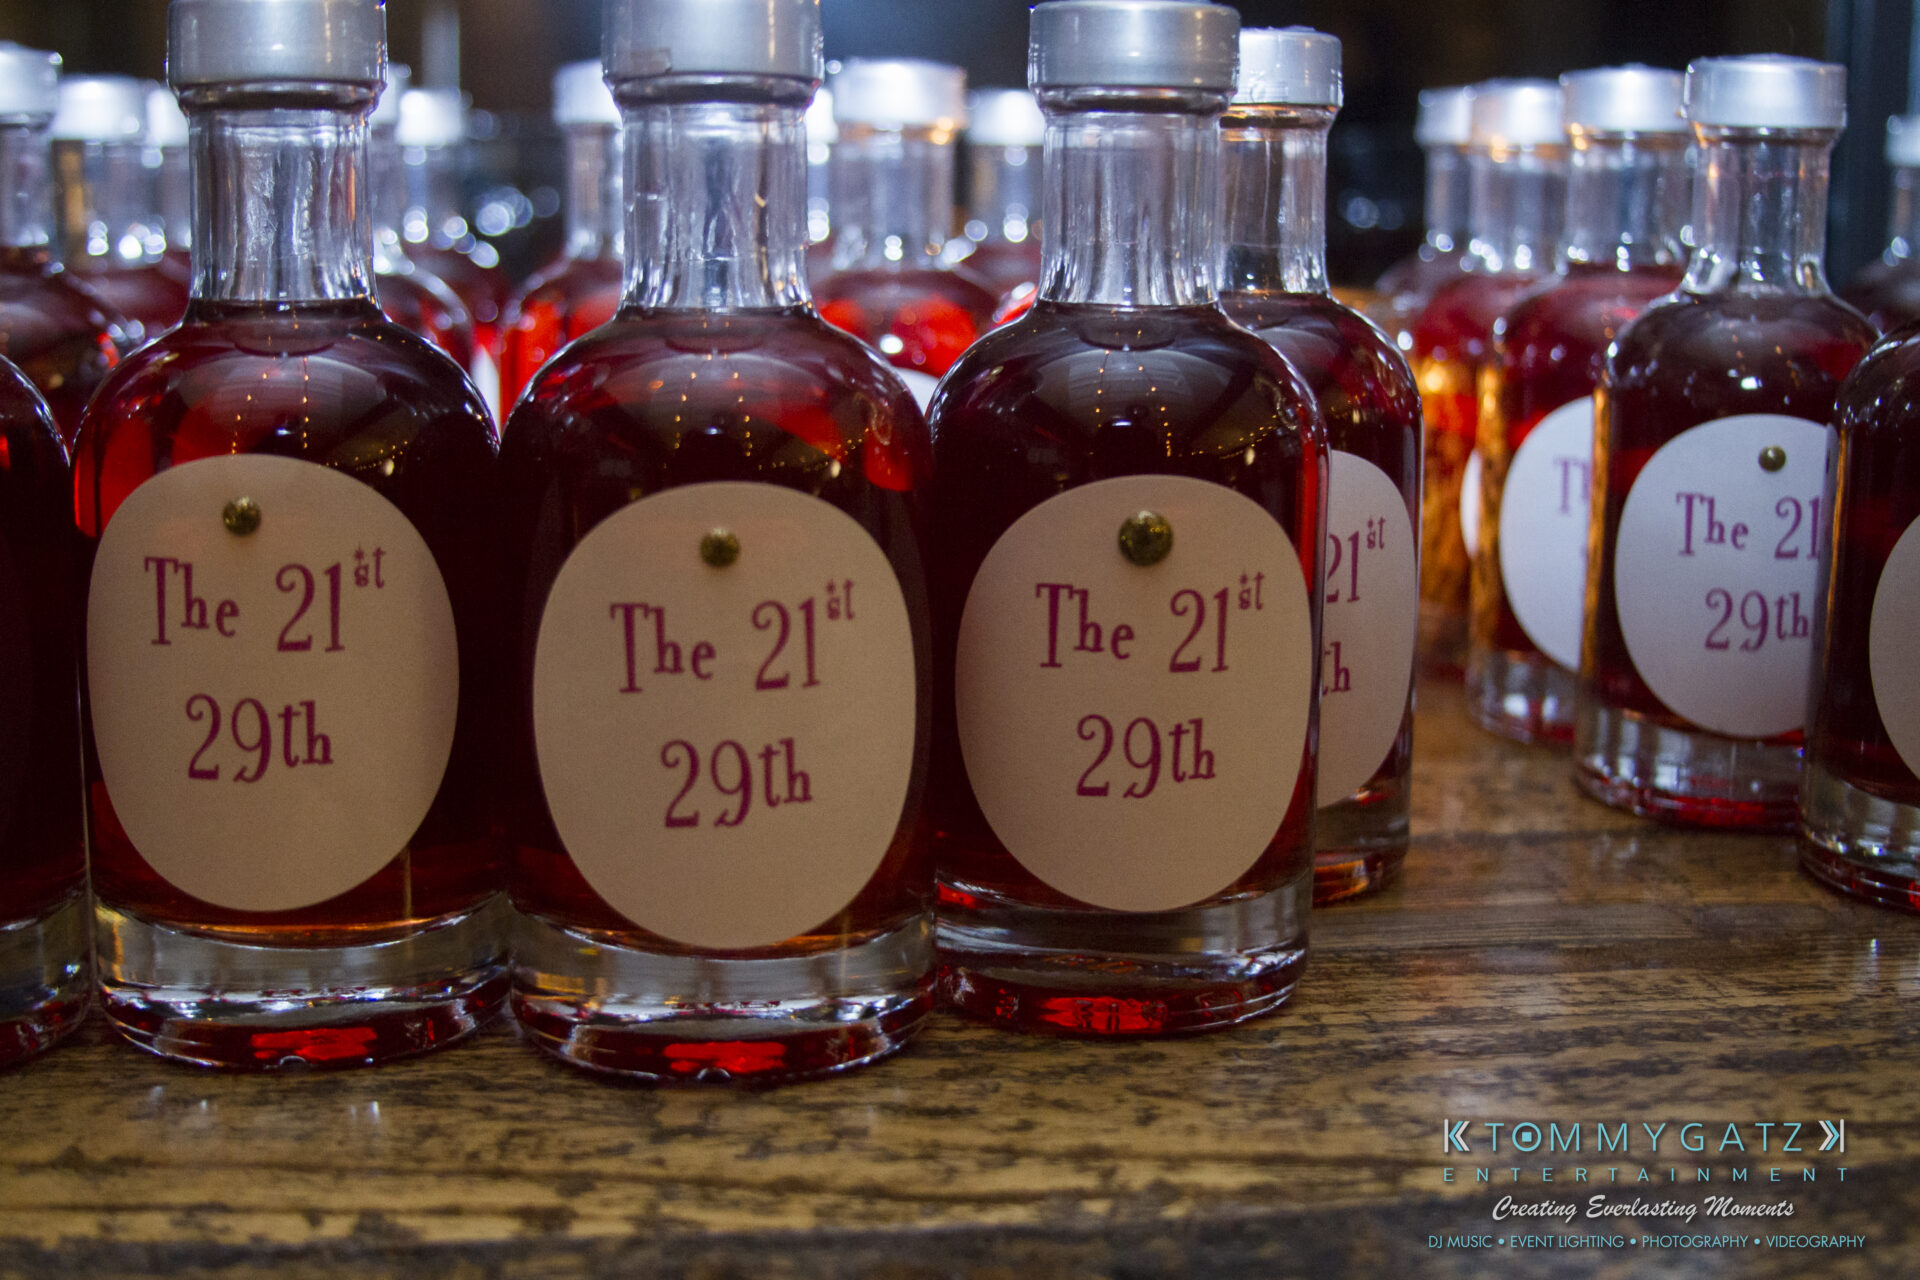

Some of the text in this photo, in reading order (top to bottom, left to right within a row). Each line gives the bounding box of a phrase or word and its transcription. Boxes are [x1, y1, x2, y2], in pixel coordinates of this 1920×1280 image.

[1676, 492, 1749, 556] The
[144, 547, 386, 652] The 21st
[610, 579, 854, 693] The 21st
[1035, 572, 1265, 673] The 21st
[1704, 587, 1809, 651] 29th
[185, 694, 333, 783] 29th
[660, 737, 813, 828] 29th
[1076, 714, 1216, 799] 29th
